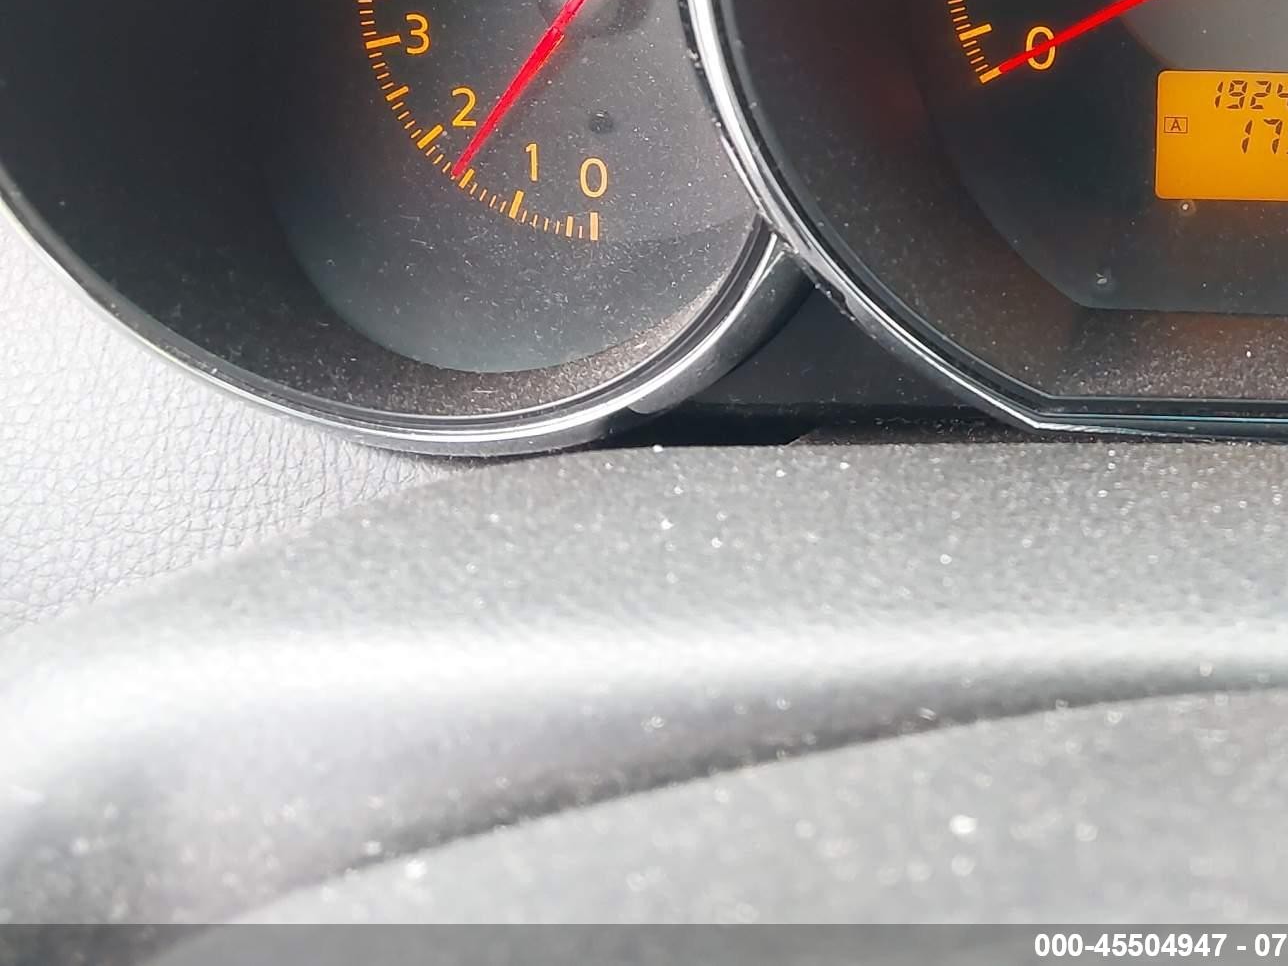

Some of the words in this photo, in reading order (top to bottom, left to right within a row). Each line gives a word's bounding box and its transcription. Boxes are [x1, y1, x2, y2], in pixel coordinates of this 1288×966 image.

[406, 14, 430, 54] 3
[1027, 27, 1055, 69] 0
[451, 88, 477, 127] 2
[1170, 118, 1181, 131] A
[525, 144, 538, 180] 1
[579, 158, 608, 197] 0
